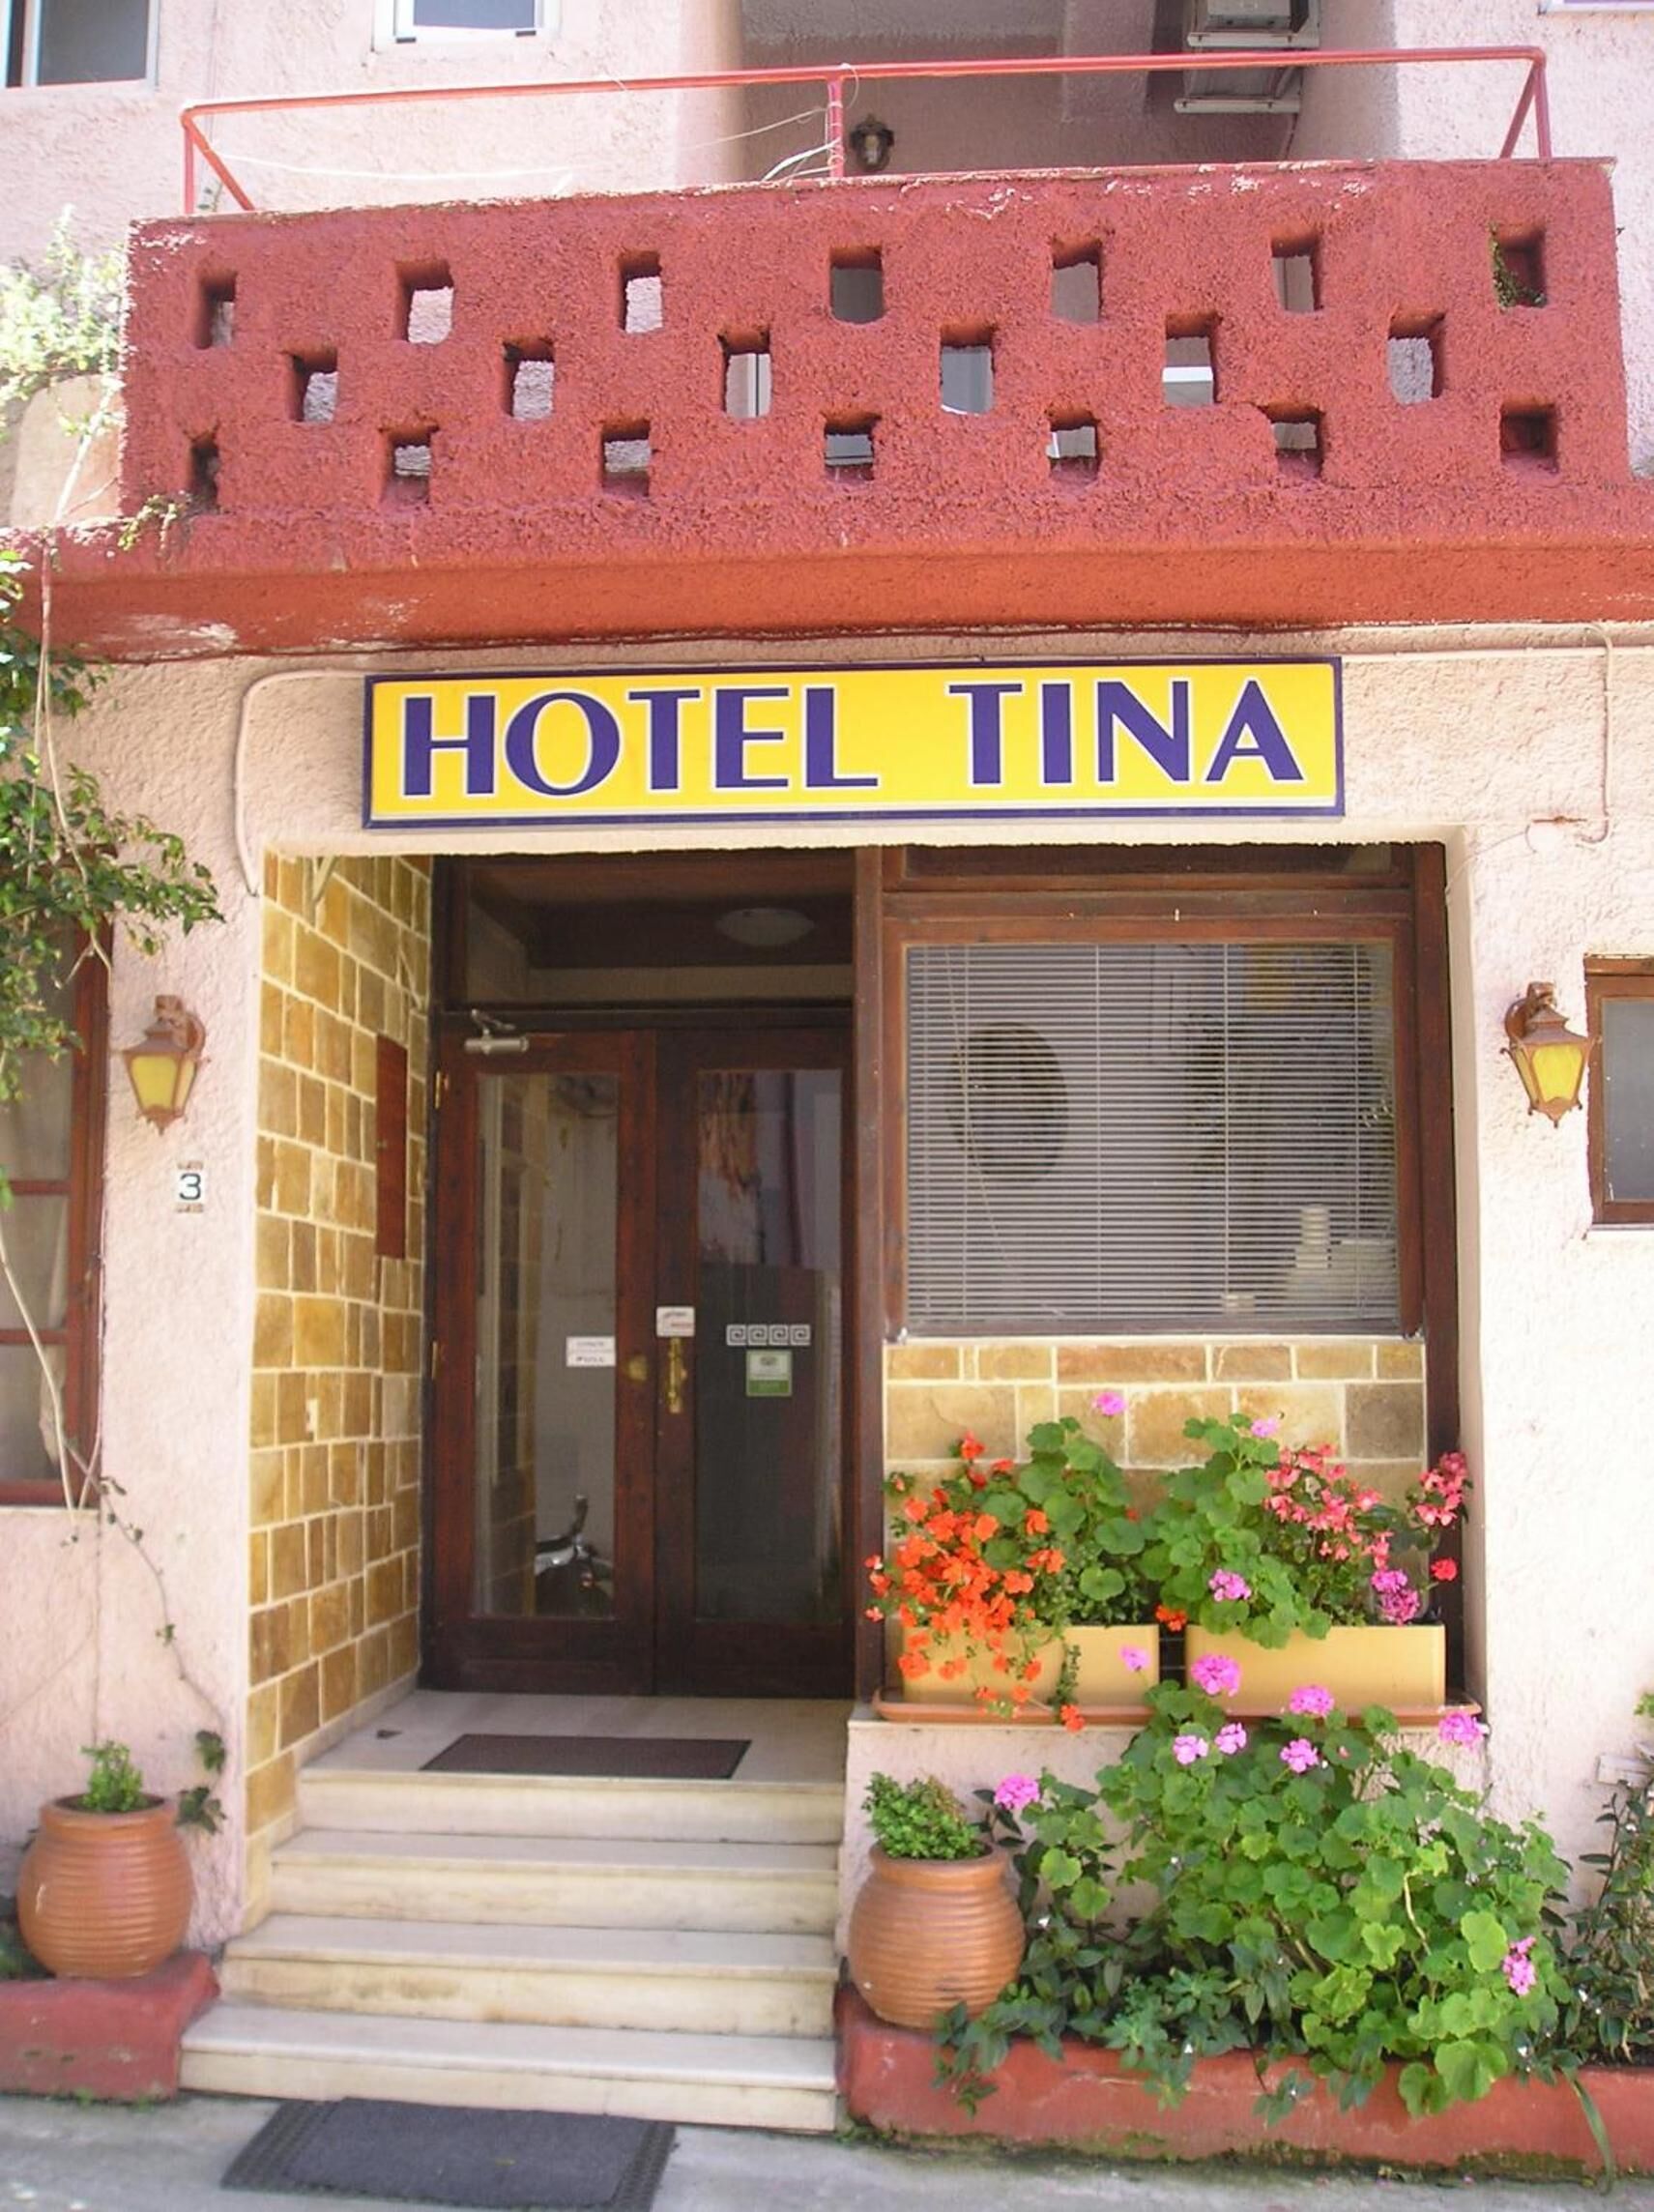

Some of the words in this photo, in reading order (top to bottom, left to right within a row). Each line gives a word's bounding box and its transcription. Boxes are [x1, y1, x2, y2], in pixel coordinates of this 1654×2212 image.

[401, 685, 878, 797] HOTEL
[948, 680, 1304, 785] TINA
[179, 1173, 201, 1201] 3
